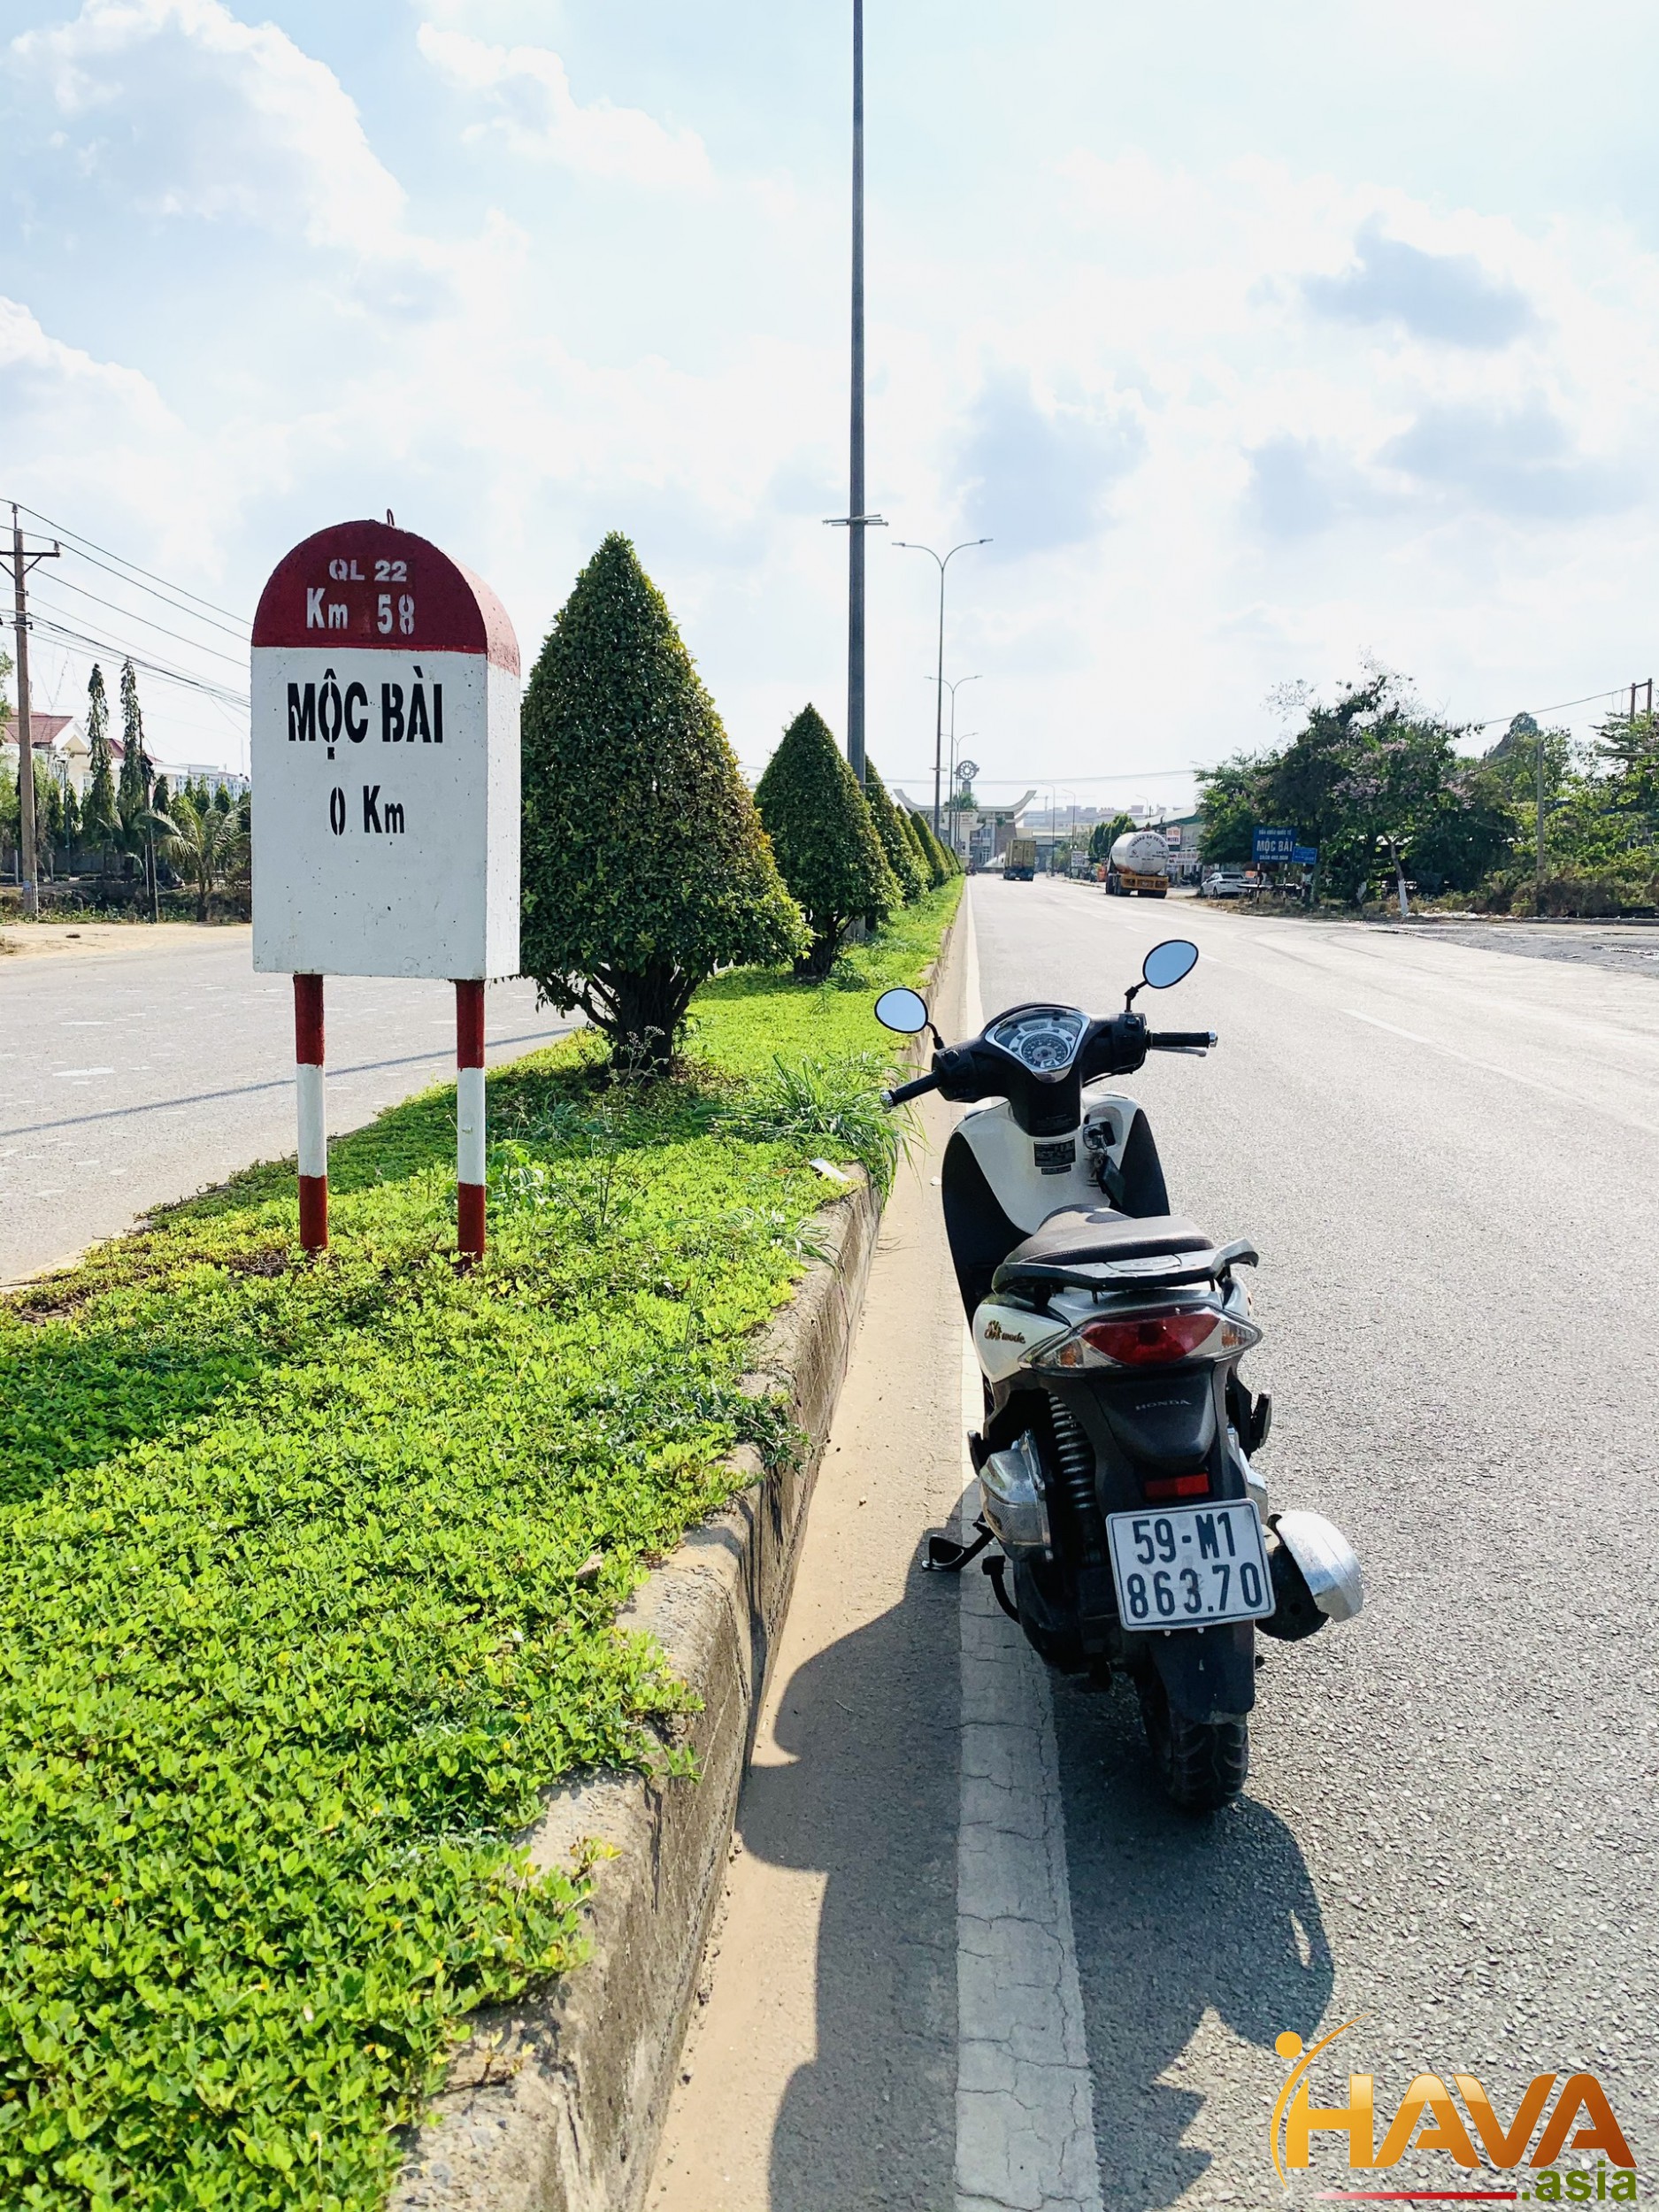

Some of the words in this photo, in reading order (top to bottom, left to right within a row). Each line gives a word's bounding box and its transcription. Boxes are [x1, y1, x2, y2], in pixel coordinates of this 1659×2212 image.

[329, 558, 365, 581] QL
[374, 559, 408, 582] 22
[306, 587, 348, 629] Km
[377, 593, 415, 635] 58
[287, 668, 369, 760] MỘC
[380, 665, 443, 743] BÀI
[330, 786, 346, 836] 0
[363, 785, 405, 833] Km
[1256, 837, 1276, 854] MỘC
[1278, 837, 1294, 852] BÀI
[1135, 1399, 1192, 1411] HONDA
[1132, 1511, 1236, 1565] 59-M1
[1126, 1562, 1263, 1619] 863.70
